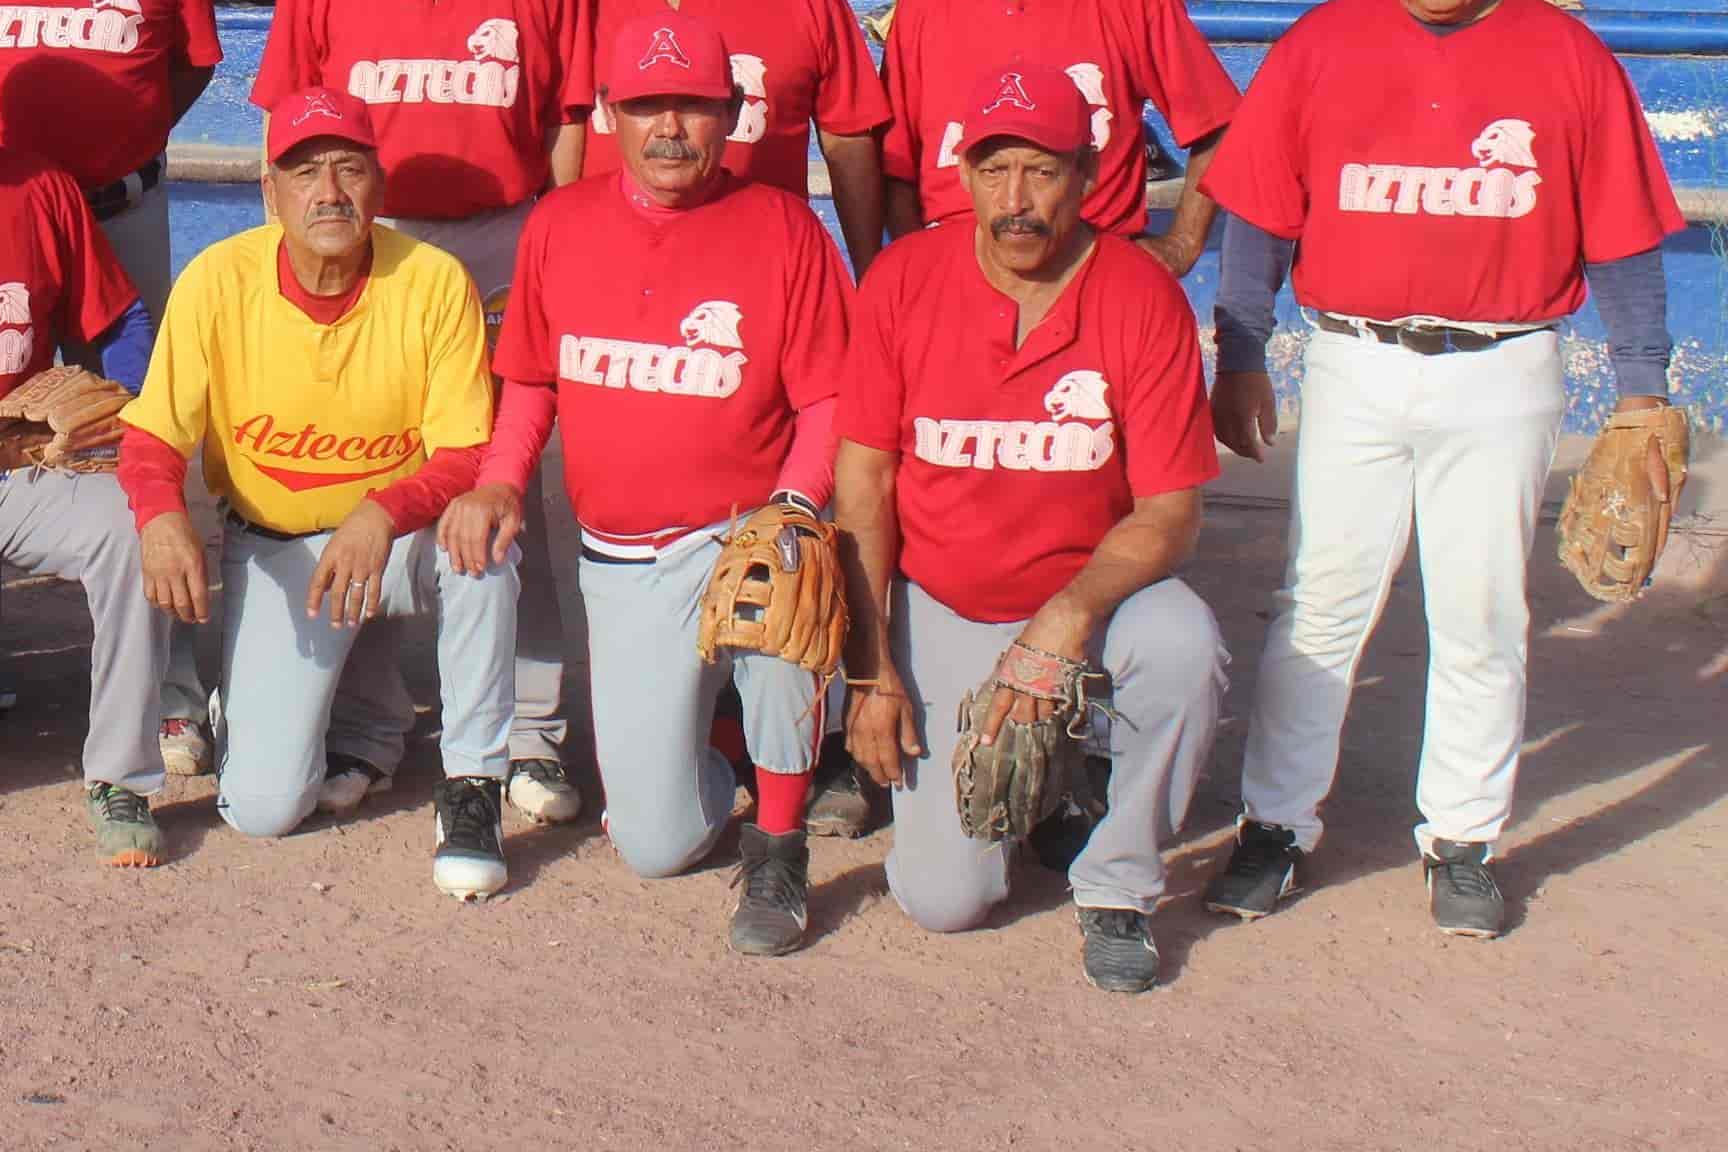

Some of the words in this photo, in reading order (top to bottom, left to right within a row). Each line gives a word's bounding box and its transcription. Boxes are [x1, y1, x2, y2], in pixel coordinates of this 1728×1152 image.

[348, 58, 521, 109] AZTECAS
[1338, 162, 1544, 219] AZTECAS
[559, 333, 751, 399] AZTECAS
[233, 413, 423, 462] Aztecas
[913, 416, 1115, 473] AZTECAS
